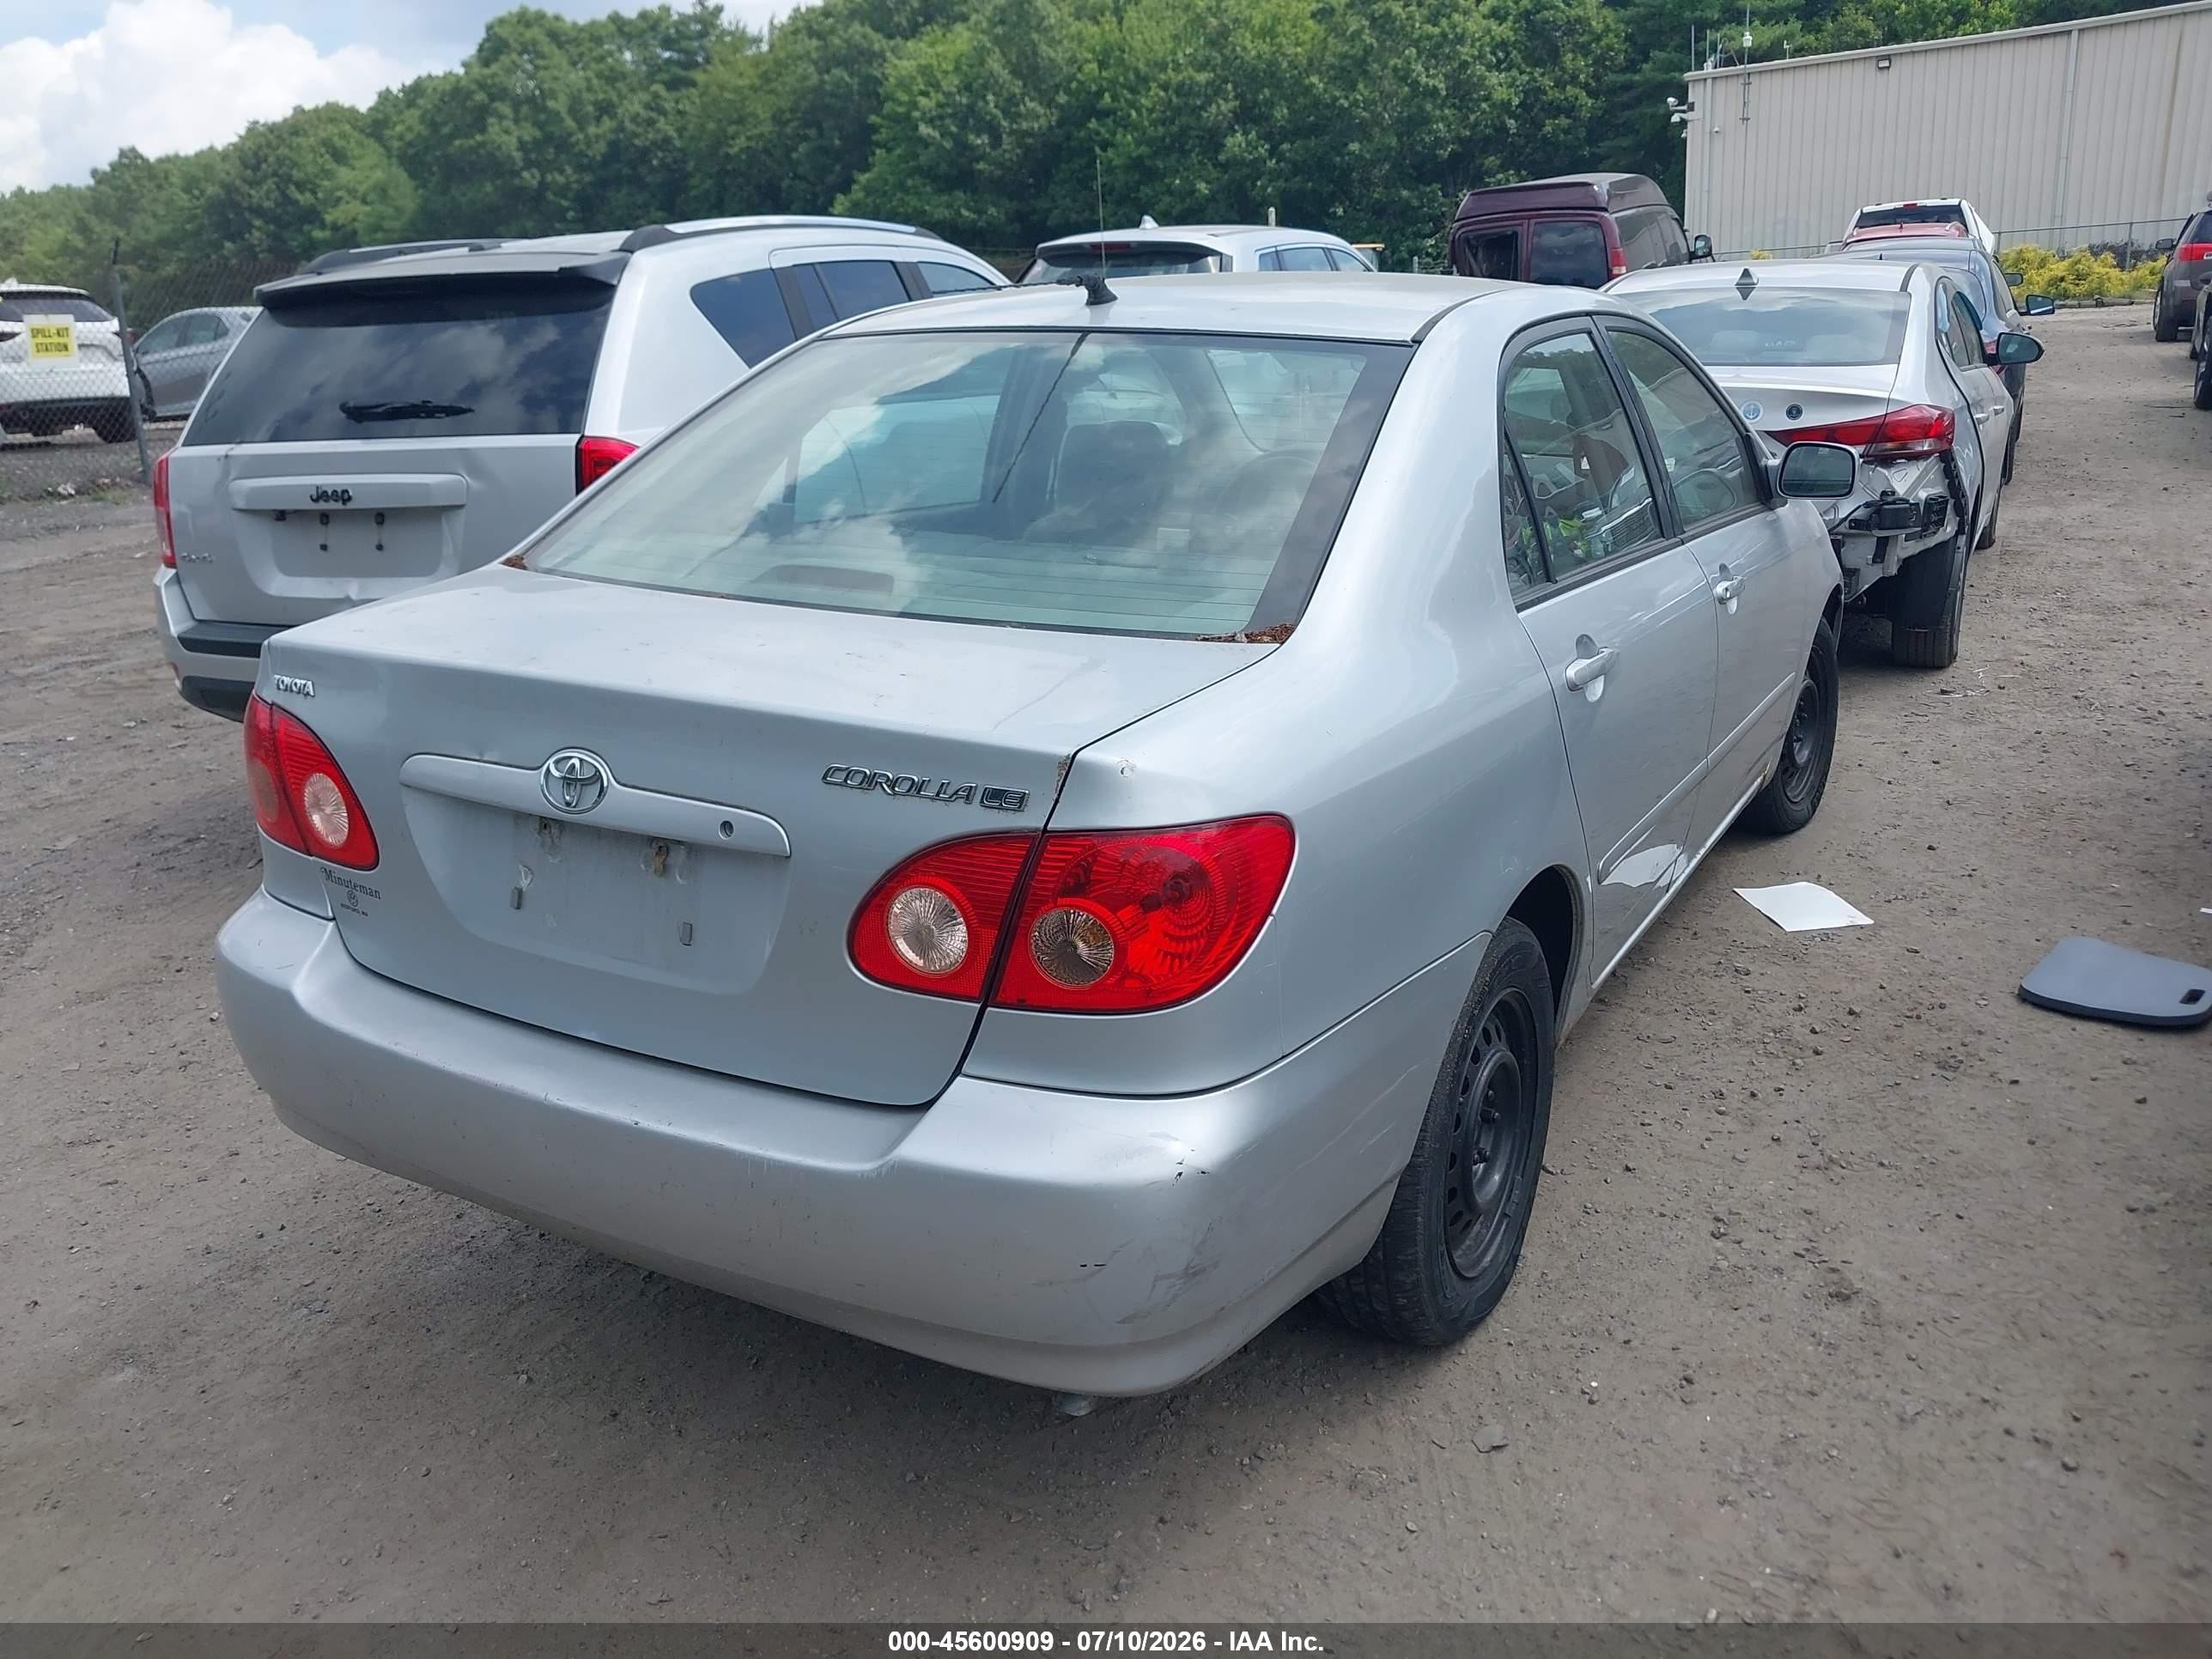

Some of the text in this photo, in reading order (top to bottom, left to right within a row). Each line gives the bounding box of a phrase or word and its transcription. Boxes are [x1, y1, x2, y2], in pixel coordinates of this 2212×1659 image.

[35, 342, 69, 353] STATION
[310, 485, 352, 506] Jeep
[274, 674, 315, 697] TOYOTA
[821, 763, 1026, 810] COROLLA LE
[319, 866, 381, 900] Minuteman
